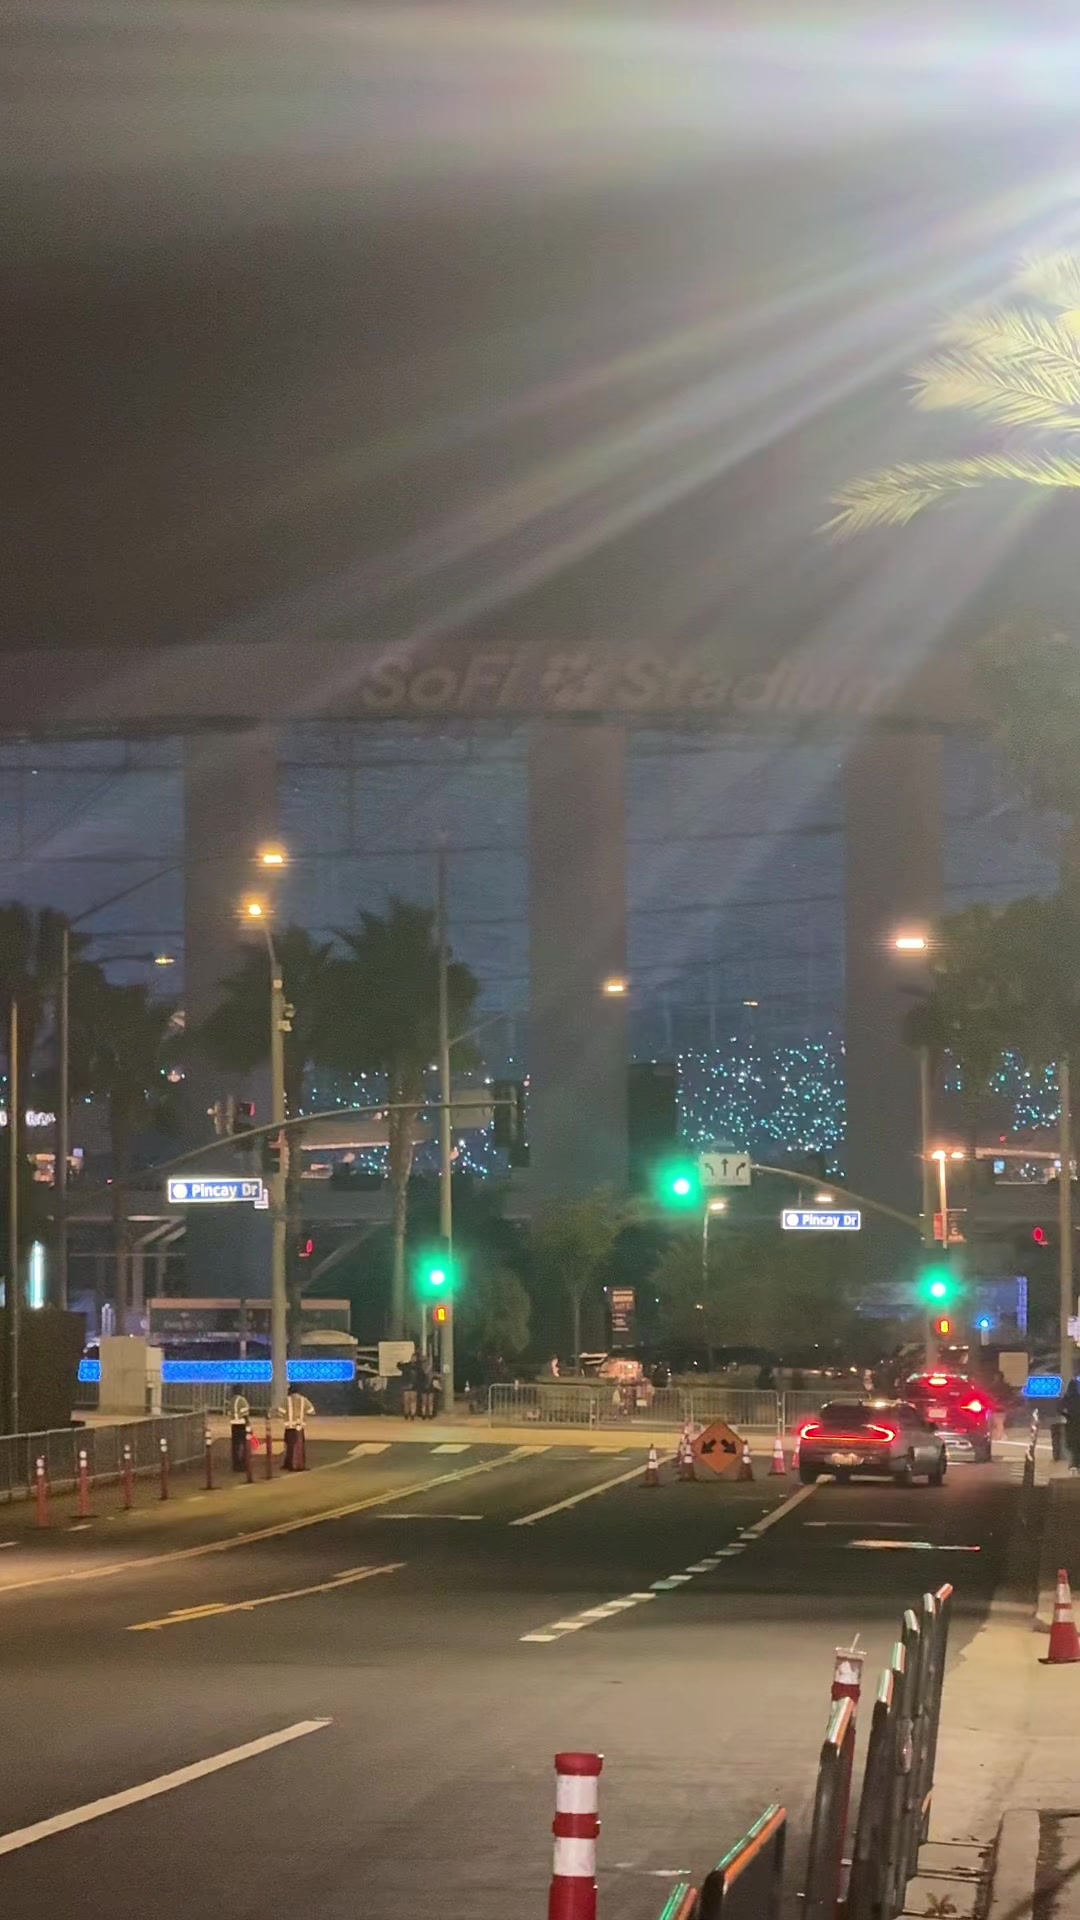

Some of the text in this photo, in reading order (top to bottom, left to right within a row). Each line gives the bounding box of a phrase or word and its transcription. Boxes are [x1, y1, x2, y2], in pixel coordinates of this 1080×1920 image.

[362, 652, 526, 708] SoFi
[191, 1183, 258, 1199] Pincay Dr
[802, 1214, 857, 1228] Pincay Dr
